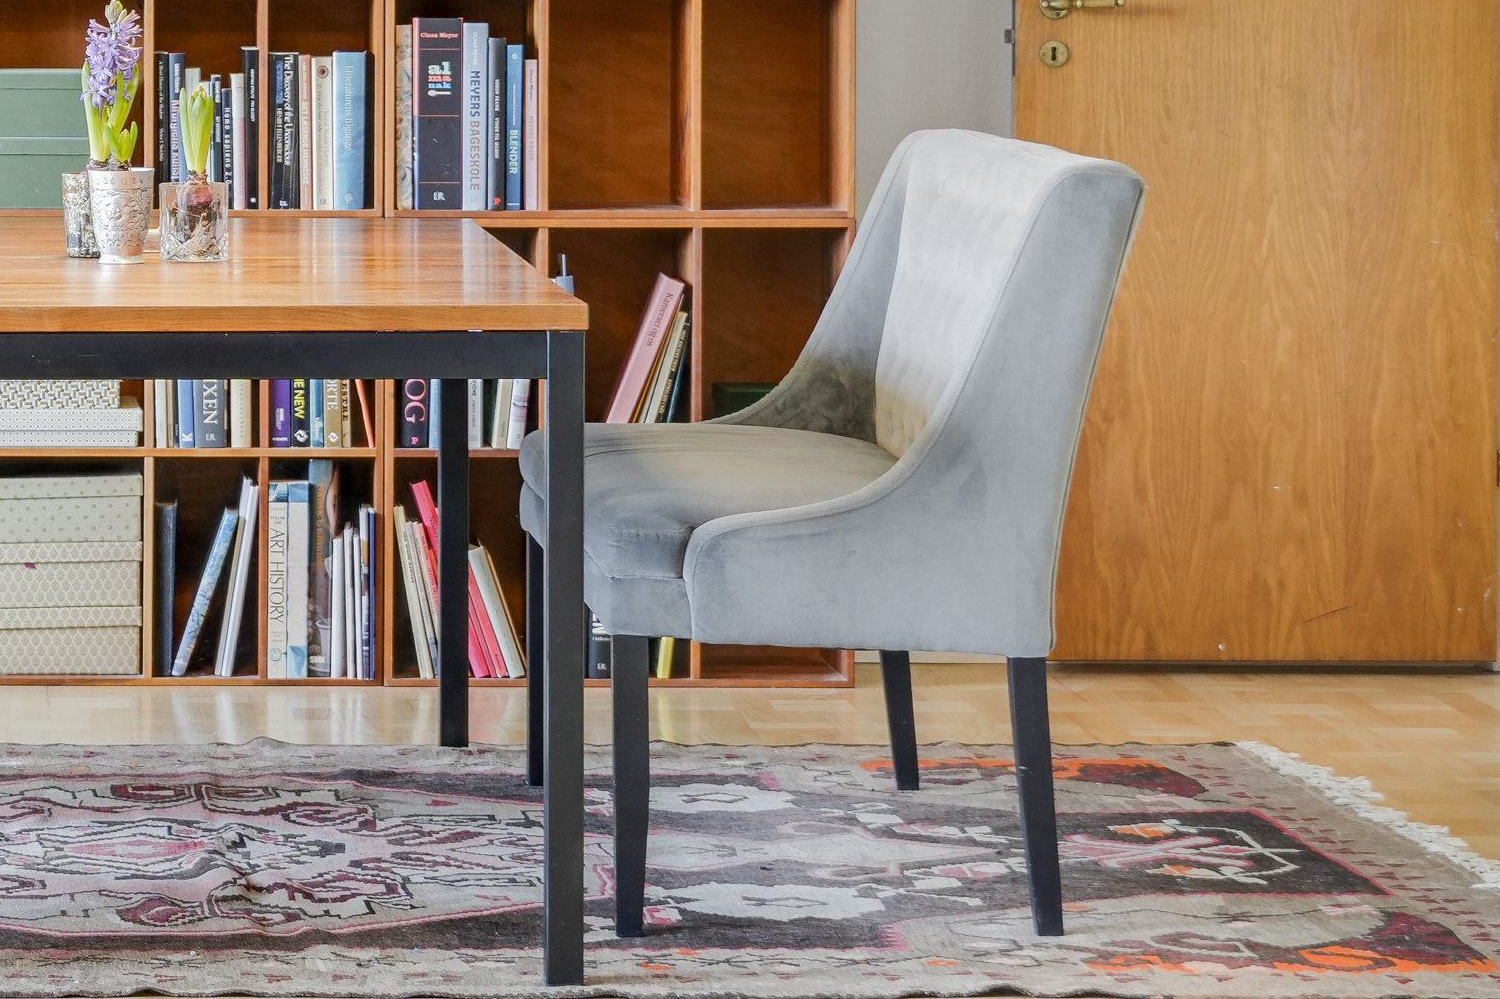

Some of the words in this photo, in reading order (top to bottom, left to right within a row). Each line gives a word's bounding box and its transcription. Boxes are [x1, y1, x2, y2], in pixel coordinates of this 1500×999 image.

[283, 55, 293, 70] The
[428, 61, 452, 75] al
[428, 74, 452, 82] ma
[283, 70, 293, 102] Discovery
[343, 64, 354, 116] Litteraturens
[428, 81, 452, 89] nak
[469, 70, 481, 118] MEYERS
[224, 107, 232, 129] Homo
[283, 103, 293, 111] of
[283, 111, 293, 123] the
[301, 101, 309, 114] DET
[276, 128, 284, 163] ELLENBERGER
[283, 123, 293, 166] Unconscious
[301, 116, 309, 148] LÆSENDE
[343, 117, 354, 150] tilgange
[224, 133, 232, 168] sapiens
[301, 148, 309, 185] MENNESKE
[469, 120, 481, 190] BAGESKOLE
[509, 129, 519, 174] BLENDER
[224, 171, 232, 183] 2.0
[653, 292, 674, 328] Kameraet
[647, 327, 658, 339] og
[293, 389, 306, 419] NEW
[269, 527, 285, 556] ART
[269, 560, 285, 624] HISTORY
